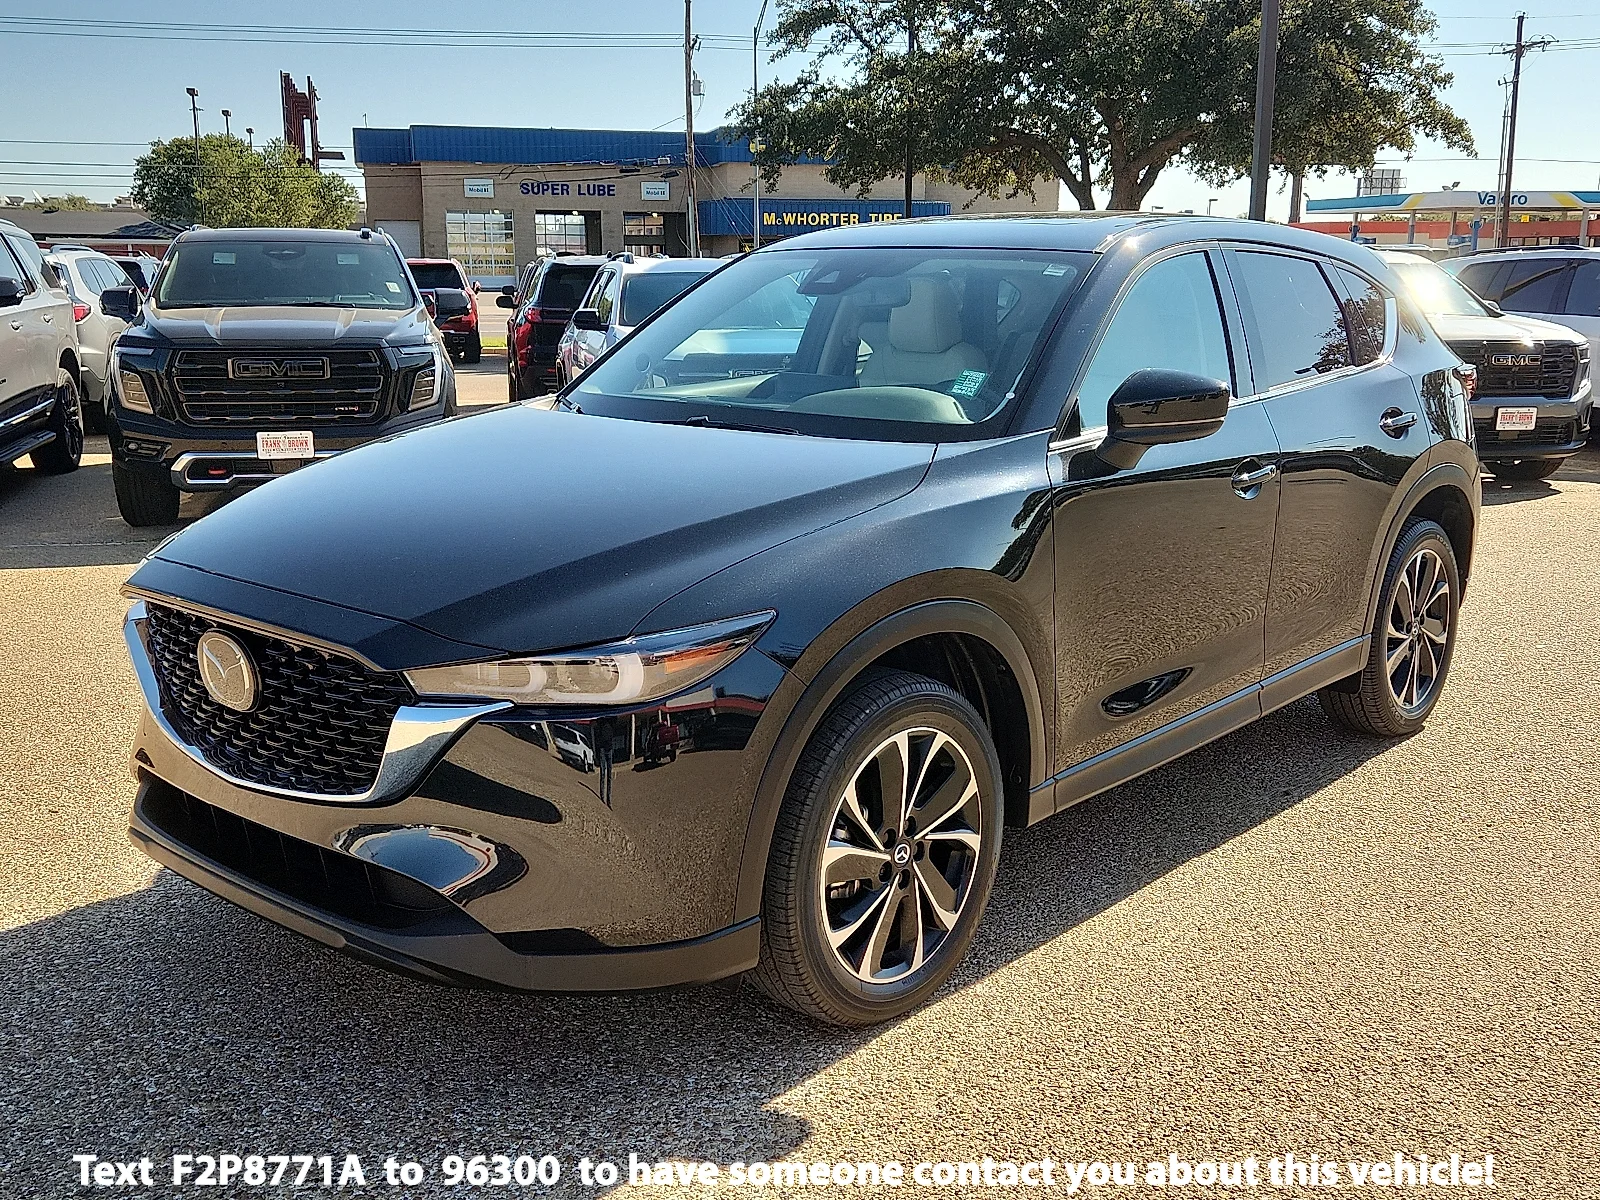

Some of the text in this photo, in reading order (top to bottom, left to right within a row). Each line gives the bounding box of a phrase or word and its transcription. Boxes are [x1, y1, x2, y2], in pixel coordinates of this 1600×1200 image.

[520, 182, 616, 197] SUPER LUBE
[1477, 192, 1528, 206] Varo
[763, 212, 860, 226] McWHORTER
[1492, 354, 1542, 366] GMC
[235, 359, 323, 378] GMC
[261, 439, 309, 449] FRANK BROWN
